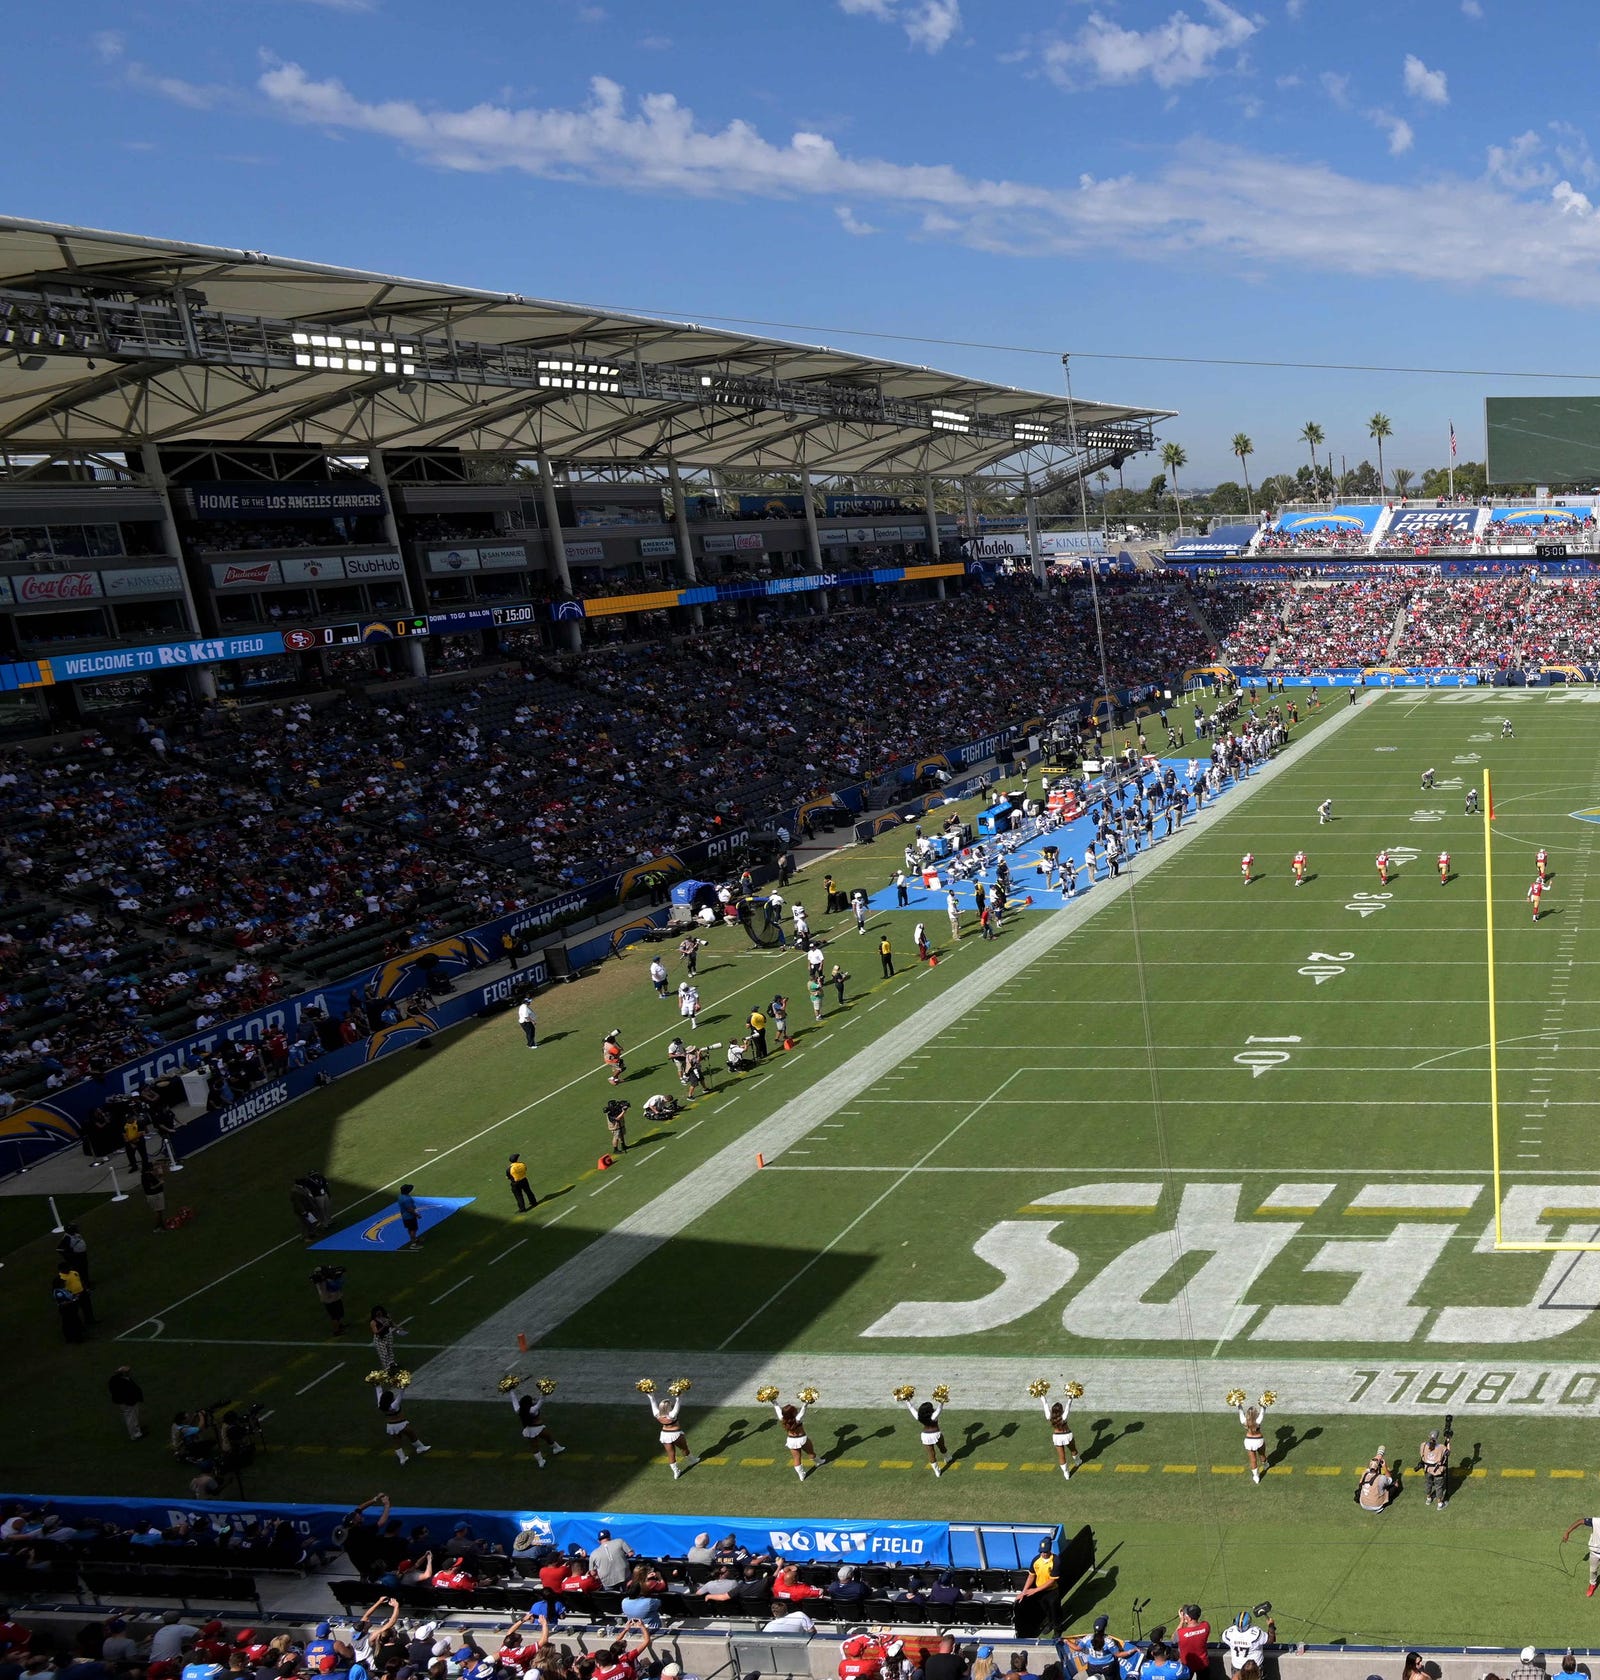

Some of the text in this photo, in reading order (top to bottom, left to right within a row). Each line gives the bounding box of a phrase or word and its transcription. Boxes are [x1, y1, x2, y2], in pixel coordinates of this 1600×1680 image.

[200, 494, 381, 509] HOME OF THE LOS ANGELES CHARGERS
[1402, 513, 1471, 522] FIGHT
[642, 540, 673, 548] AMERICAN
[976, 540, 1014, 554] Modelo
[1056, 537, 1100, 548] KINECTA
[576, 546, 602, 555] TOYOTA
[1541, 546, 1565, 556] 15:00
[227, 566, 268, 581] Budweiser
[348, 559, 399, 574] StubHub
[22, 573, 94, 600] Coca-Cola
[127, 576, 175, 587] KINECTA
[429, 609, 490, 622] DOWN TO GO BALL ON
[505, 607, 531, 622] 15:00
[396, 621, 406, 635] 0
[324, 629, 334, 643] 0
[66, 654, 134, 674] WELCOME
[136, 651, 154, 666] TO
[230, 638, 264, 655] FIELD
[1387, 690, 1543, 704] LOS
[961, 741, 984, 763] FIGHT
[1345, 893, 1393, 910] 30
[1298, 952, 1354, 976] 20
[483, 972, 525, 1005] FIGHT
[1234, 1035, 1302, 1065] 10
[219, 1082, 288, 1133] CHARGERS
[872, 1537, 924, 1554] FIELD
[1233, 1646, 1250, 1658] 17
